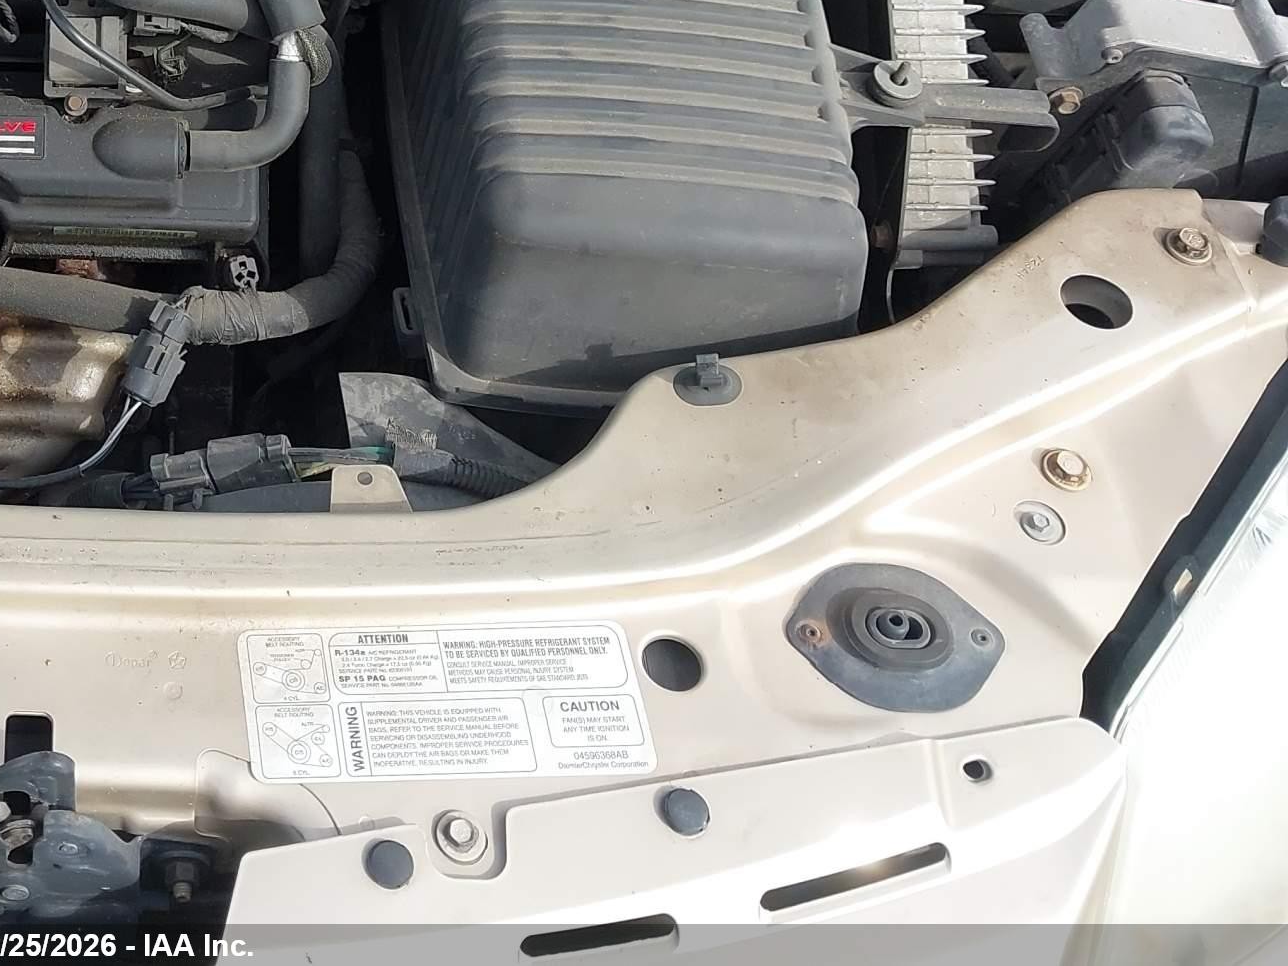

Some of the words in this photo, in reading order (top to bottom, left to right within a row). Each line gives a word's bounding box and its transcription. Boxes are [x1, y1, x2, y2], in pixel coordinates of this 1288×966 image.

[358, 634, 408, 644] ATTENTION
[443, 641, 476, 649] WARNING:
[480, 639, 533, 648] HIGH-PRESSURE
[535, 638, 580, 647] REFRIGERANT
[582, 637, 610, 645] SYSTEM
[445, 651, 454, 659] TO
[466, 650, 498, 658] SERVICED
[500, 649, 508, 657] BY
[511, 648, 546, 657] QUALIFIED
[548, 647, 587, 656] PERSONNEL
[560, 701, 620, 712] CAUTION
[346, 706, 365, 771] WARNING
[611, 761, 648, 769] Corporation
